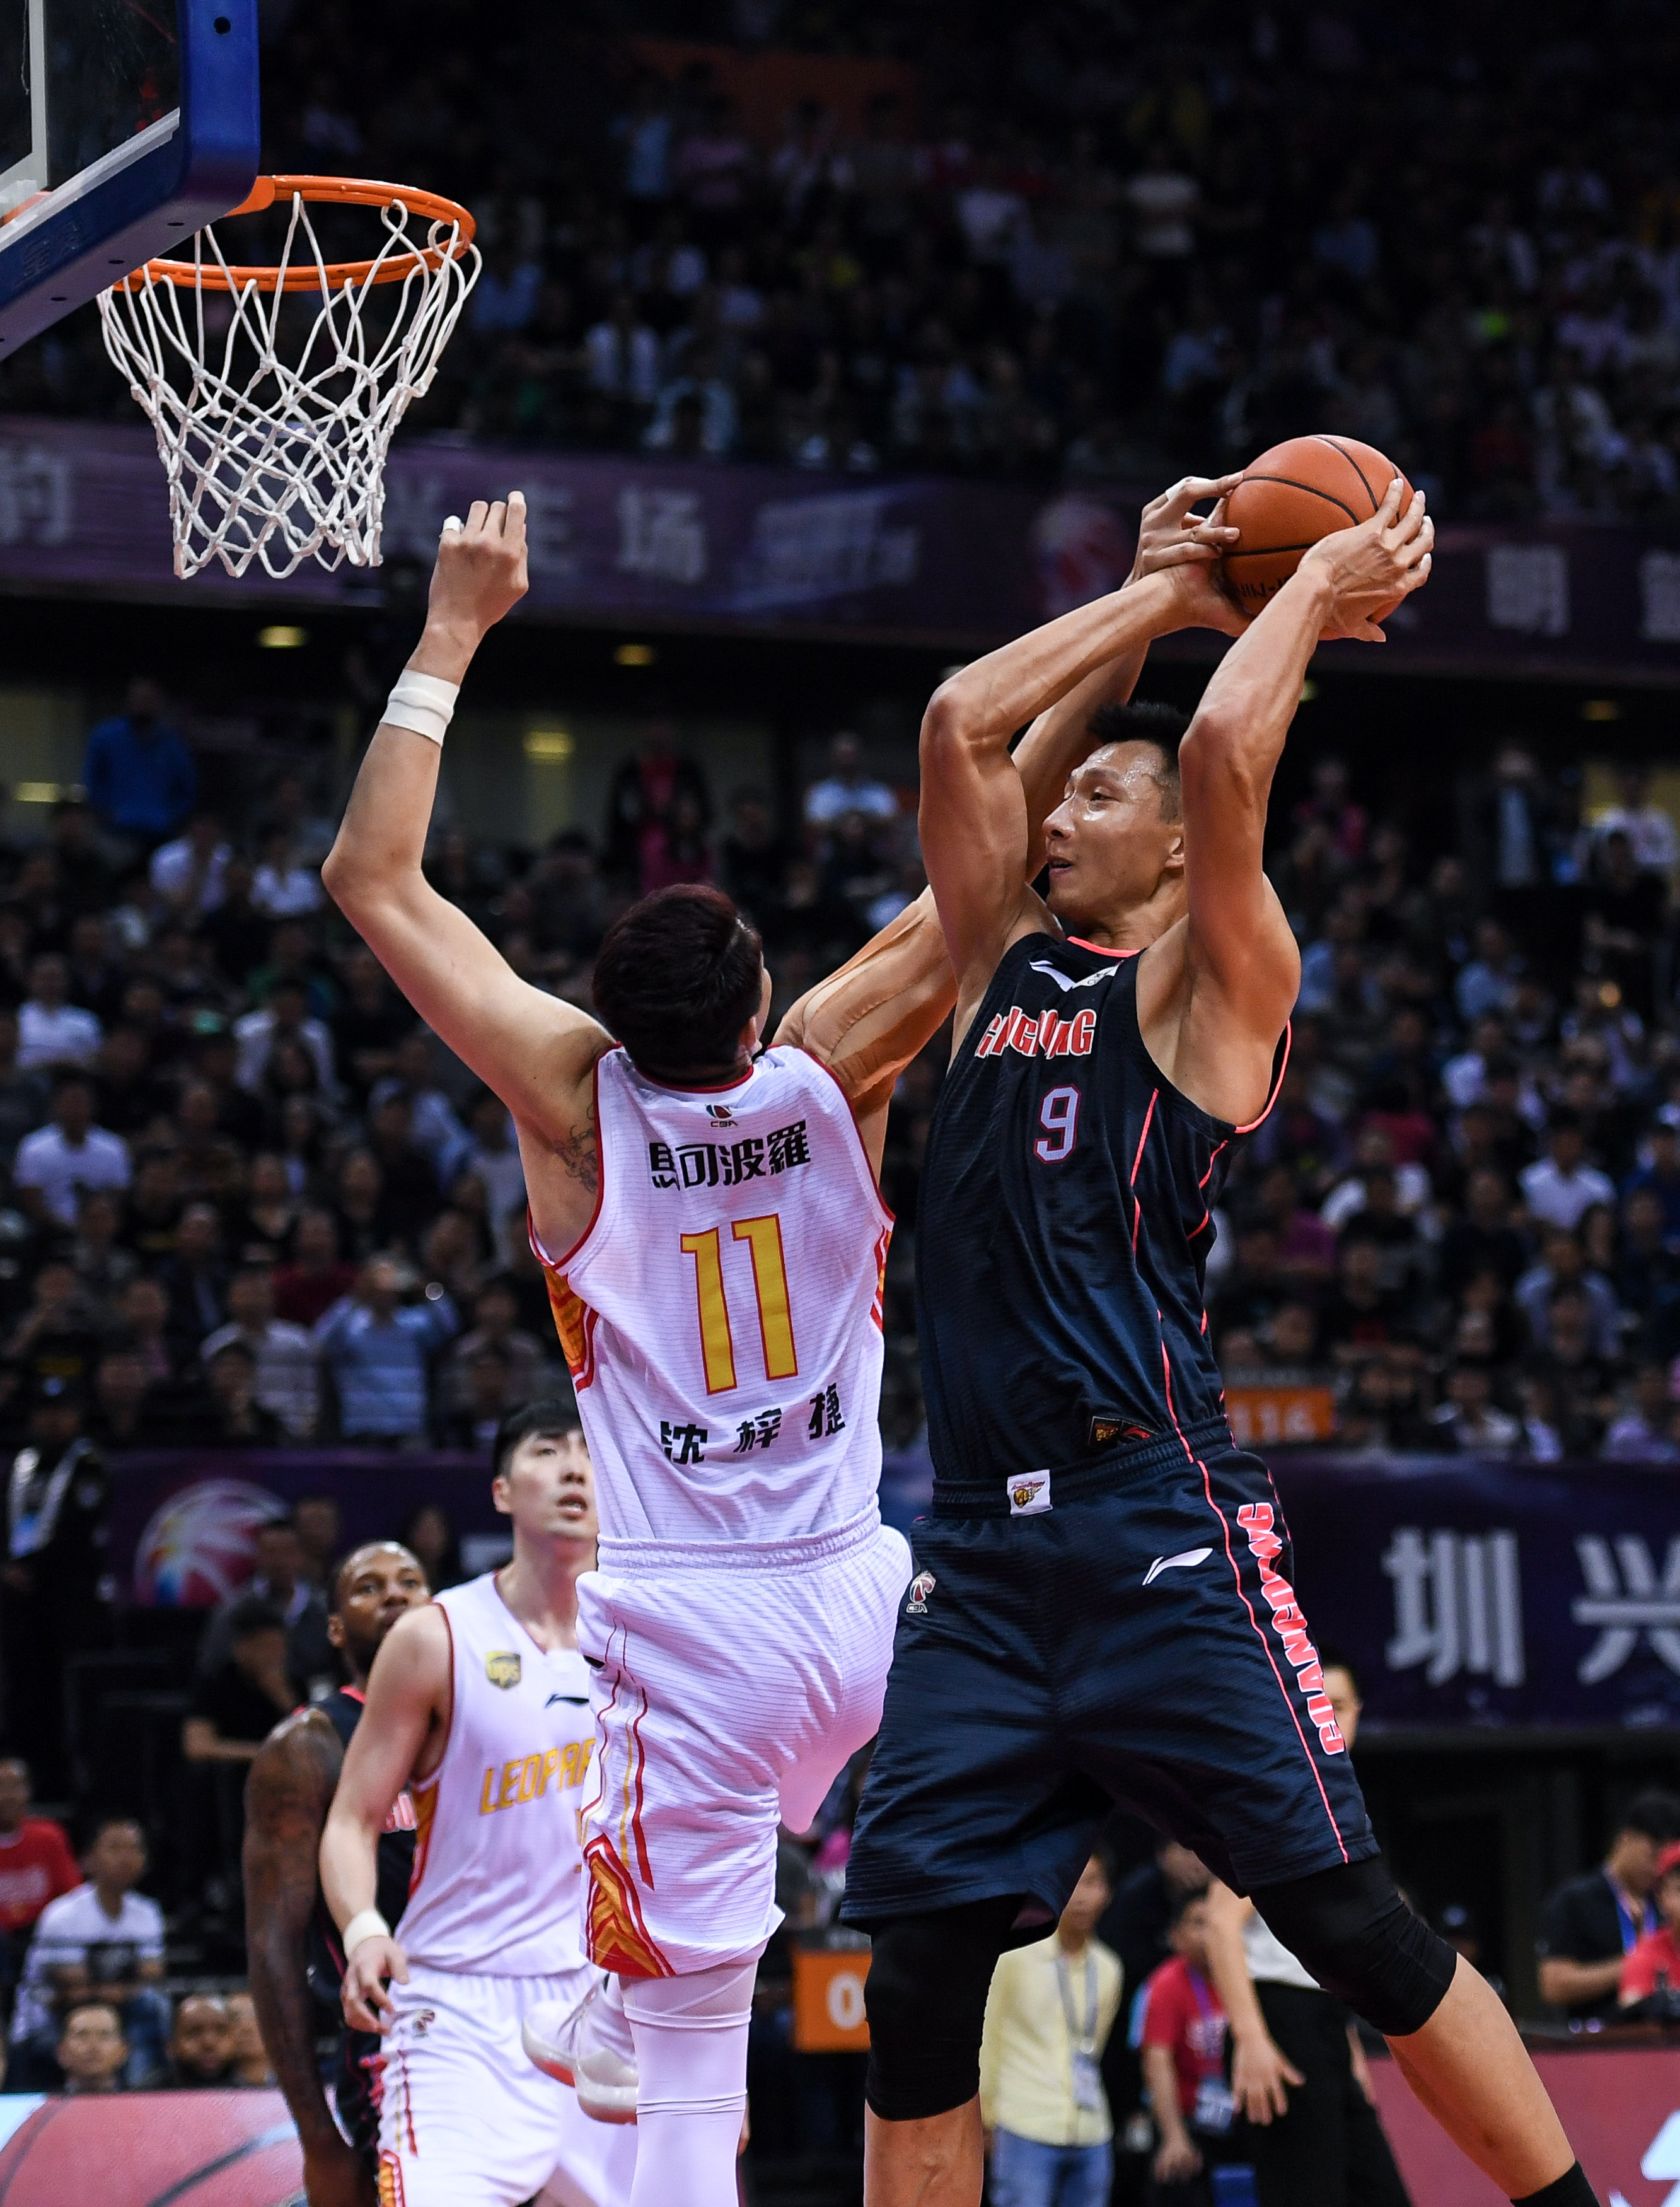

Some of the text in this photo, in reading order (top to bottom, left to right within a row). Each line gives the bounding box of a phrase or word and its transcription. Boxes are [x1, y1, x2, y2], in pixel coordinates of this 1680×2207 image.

[1033, 1084, 1081, 1164] 9
[680, 1213, 797, 1395] 11
[907, 1604, 927, 1613] CBA
